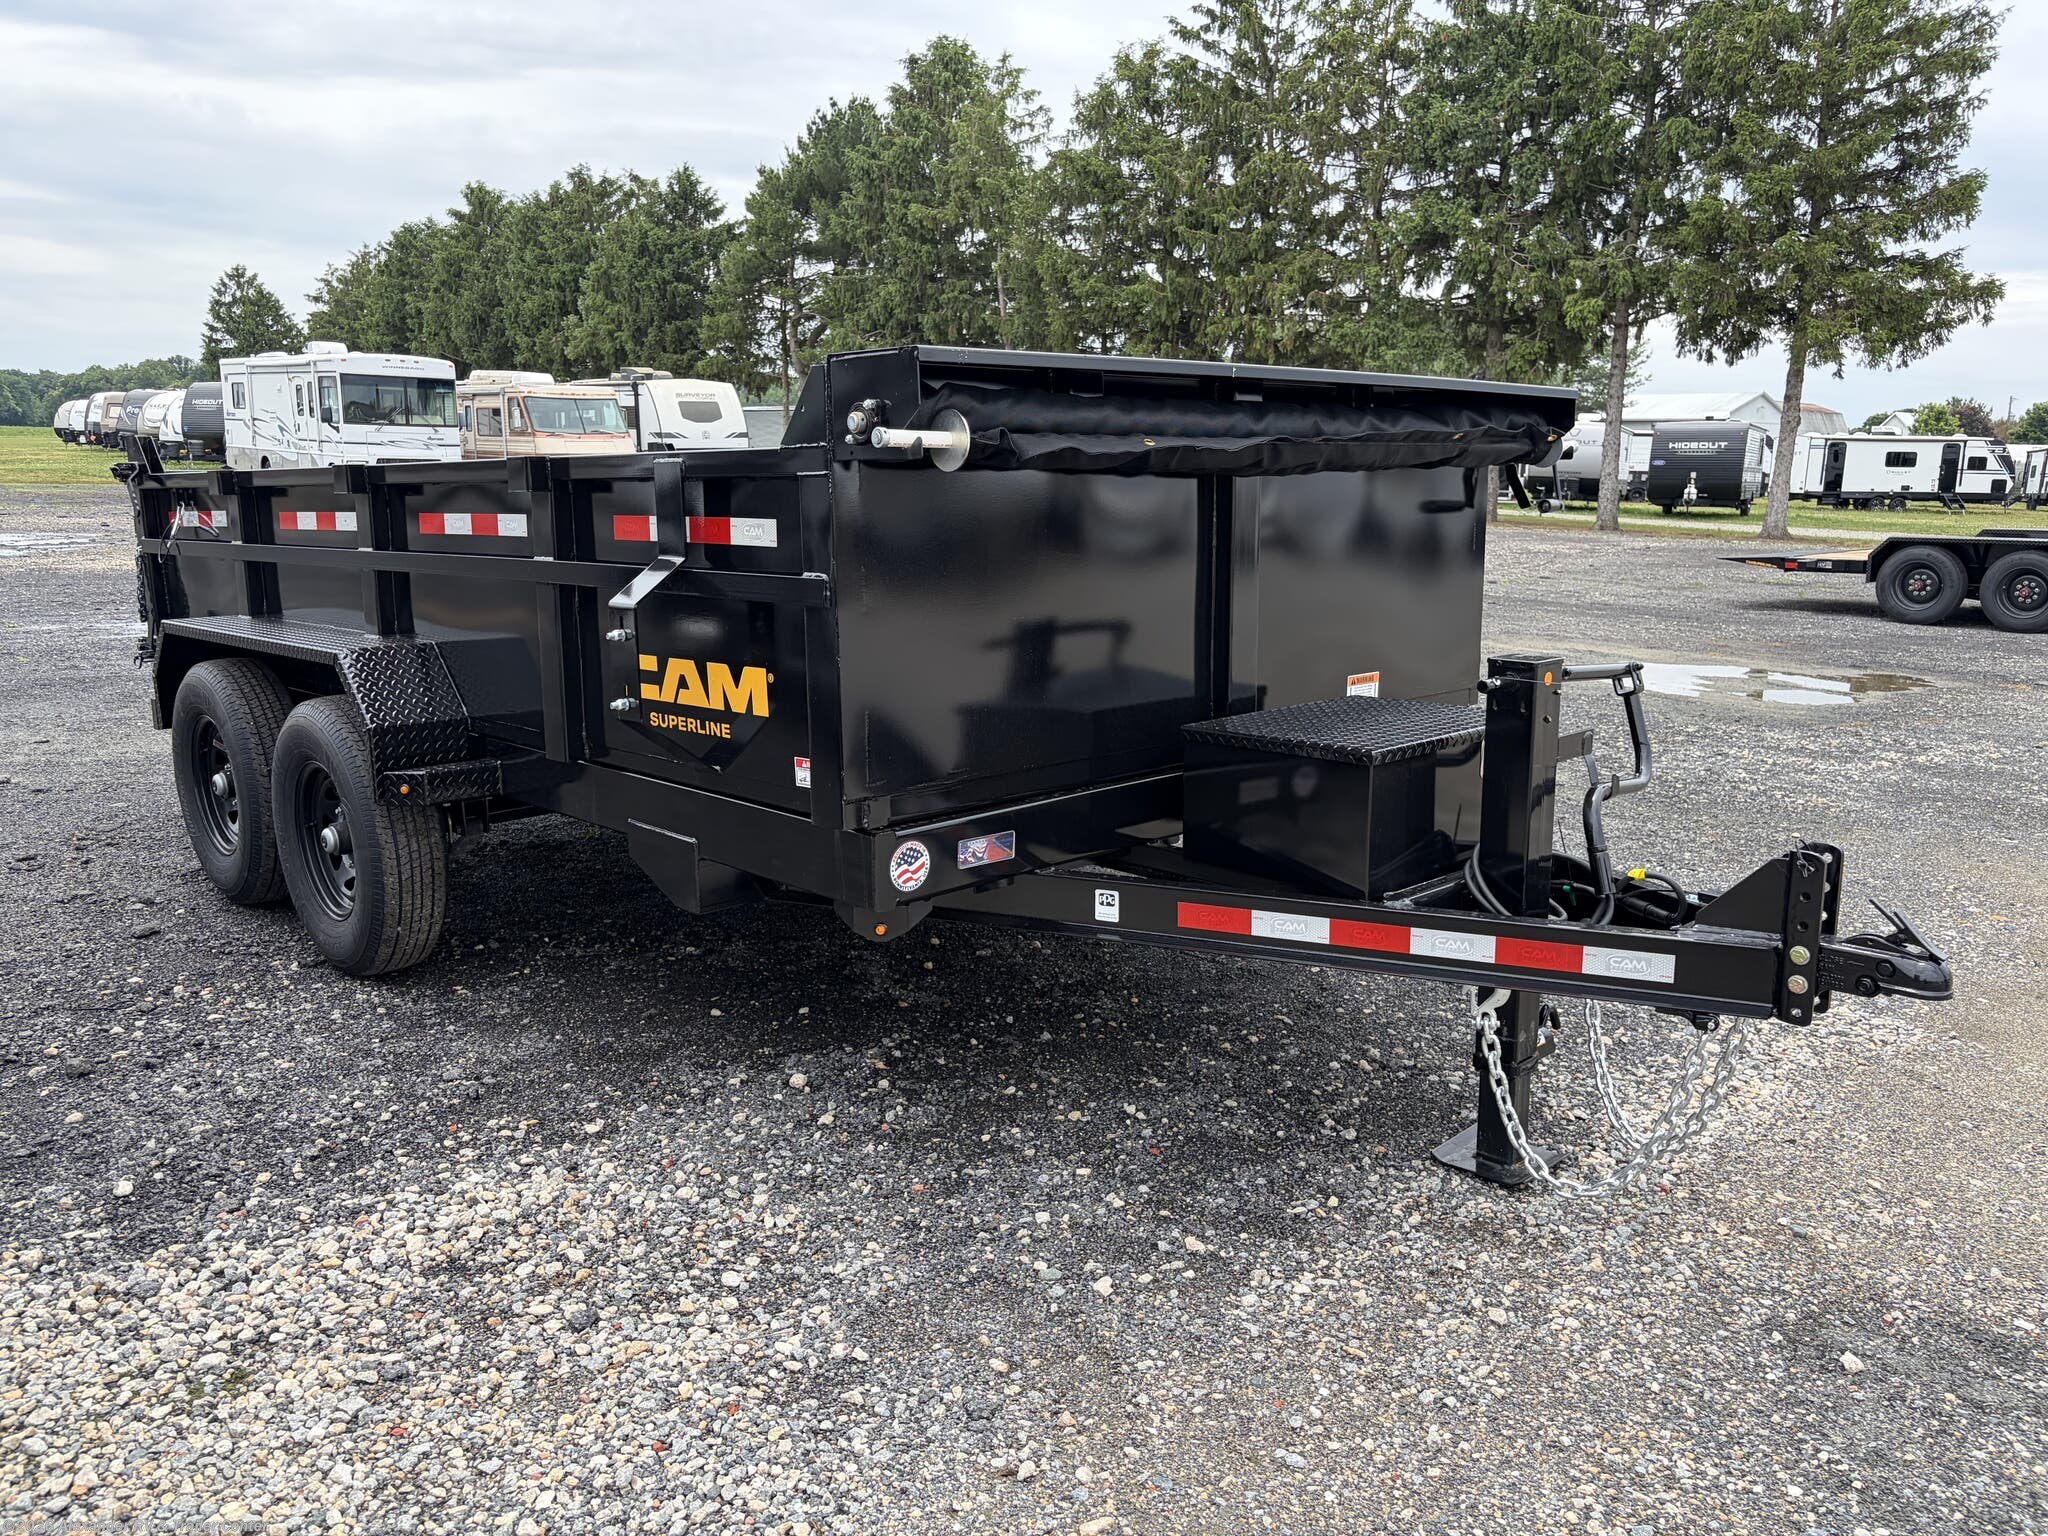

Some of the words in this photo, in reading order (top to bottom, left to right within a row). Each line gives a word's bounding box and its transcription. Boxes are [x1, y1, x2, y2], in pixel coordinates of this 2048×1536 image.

[743, 524, 763, 537] CAM
[650, 711, 731, 739] SUPERLINE
[1099, 894, 1115, 906] PPG
[1274, 920, 1306, 933] CAM
[1353, 929, 1386, 942] CAM
[1435, 937, 1470, 951] CAM
[1521, 948, 1556, 961] CAM
[1609, 957, 1647, 972] CAM
